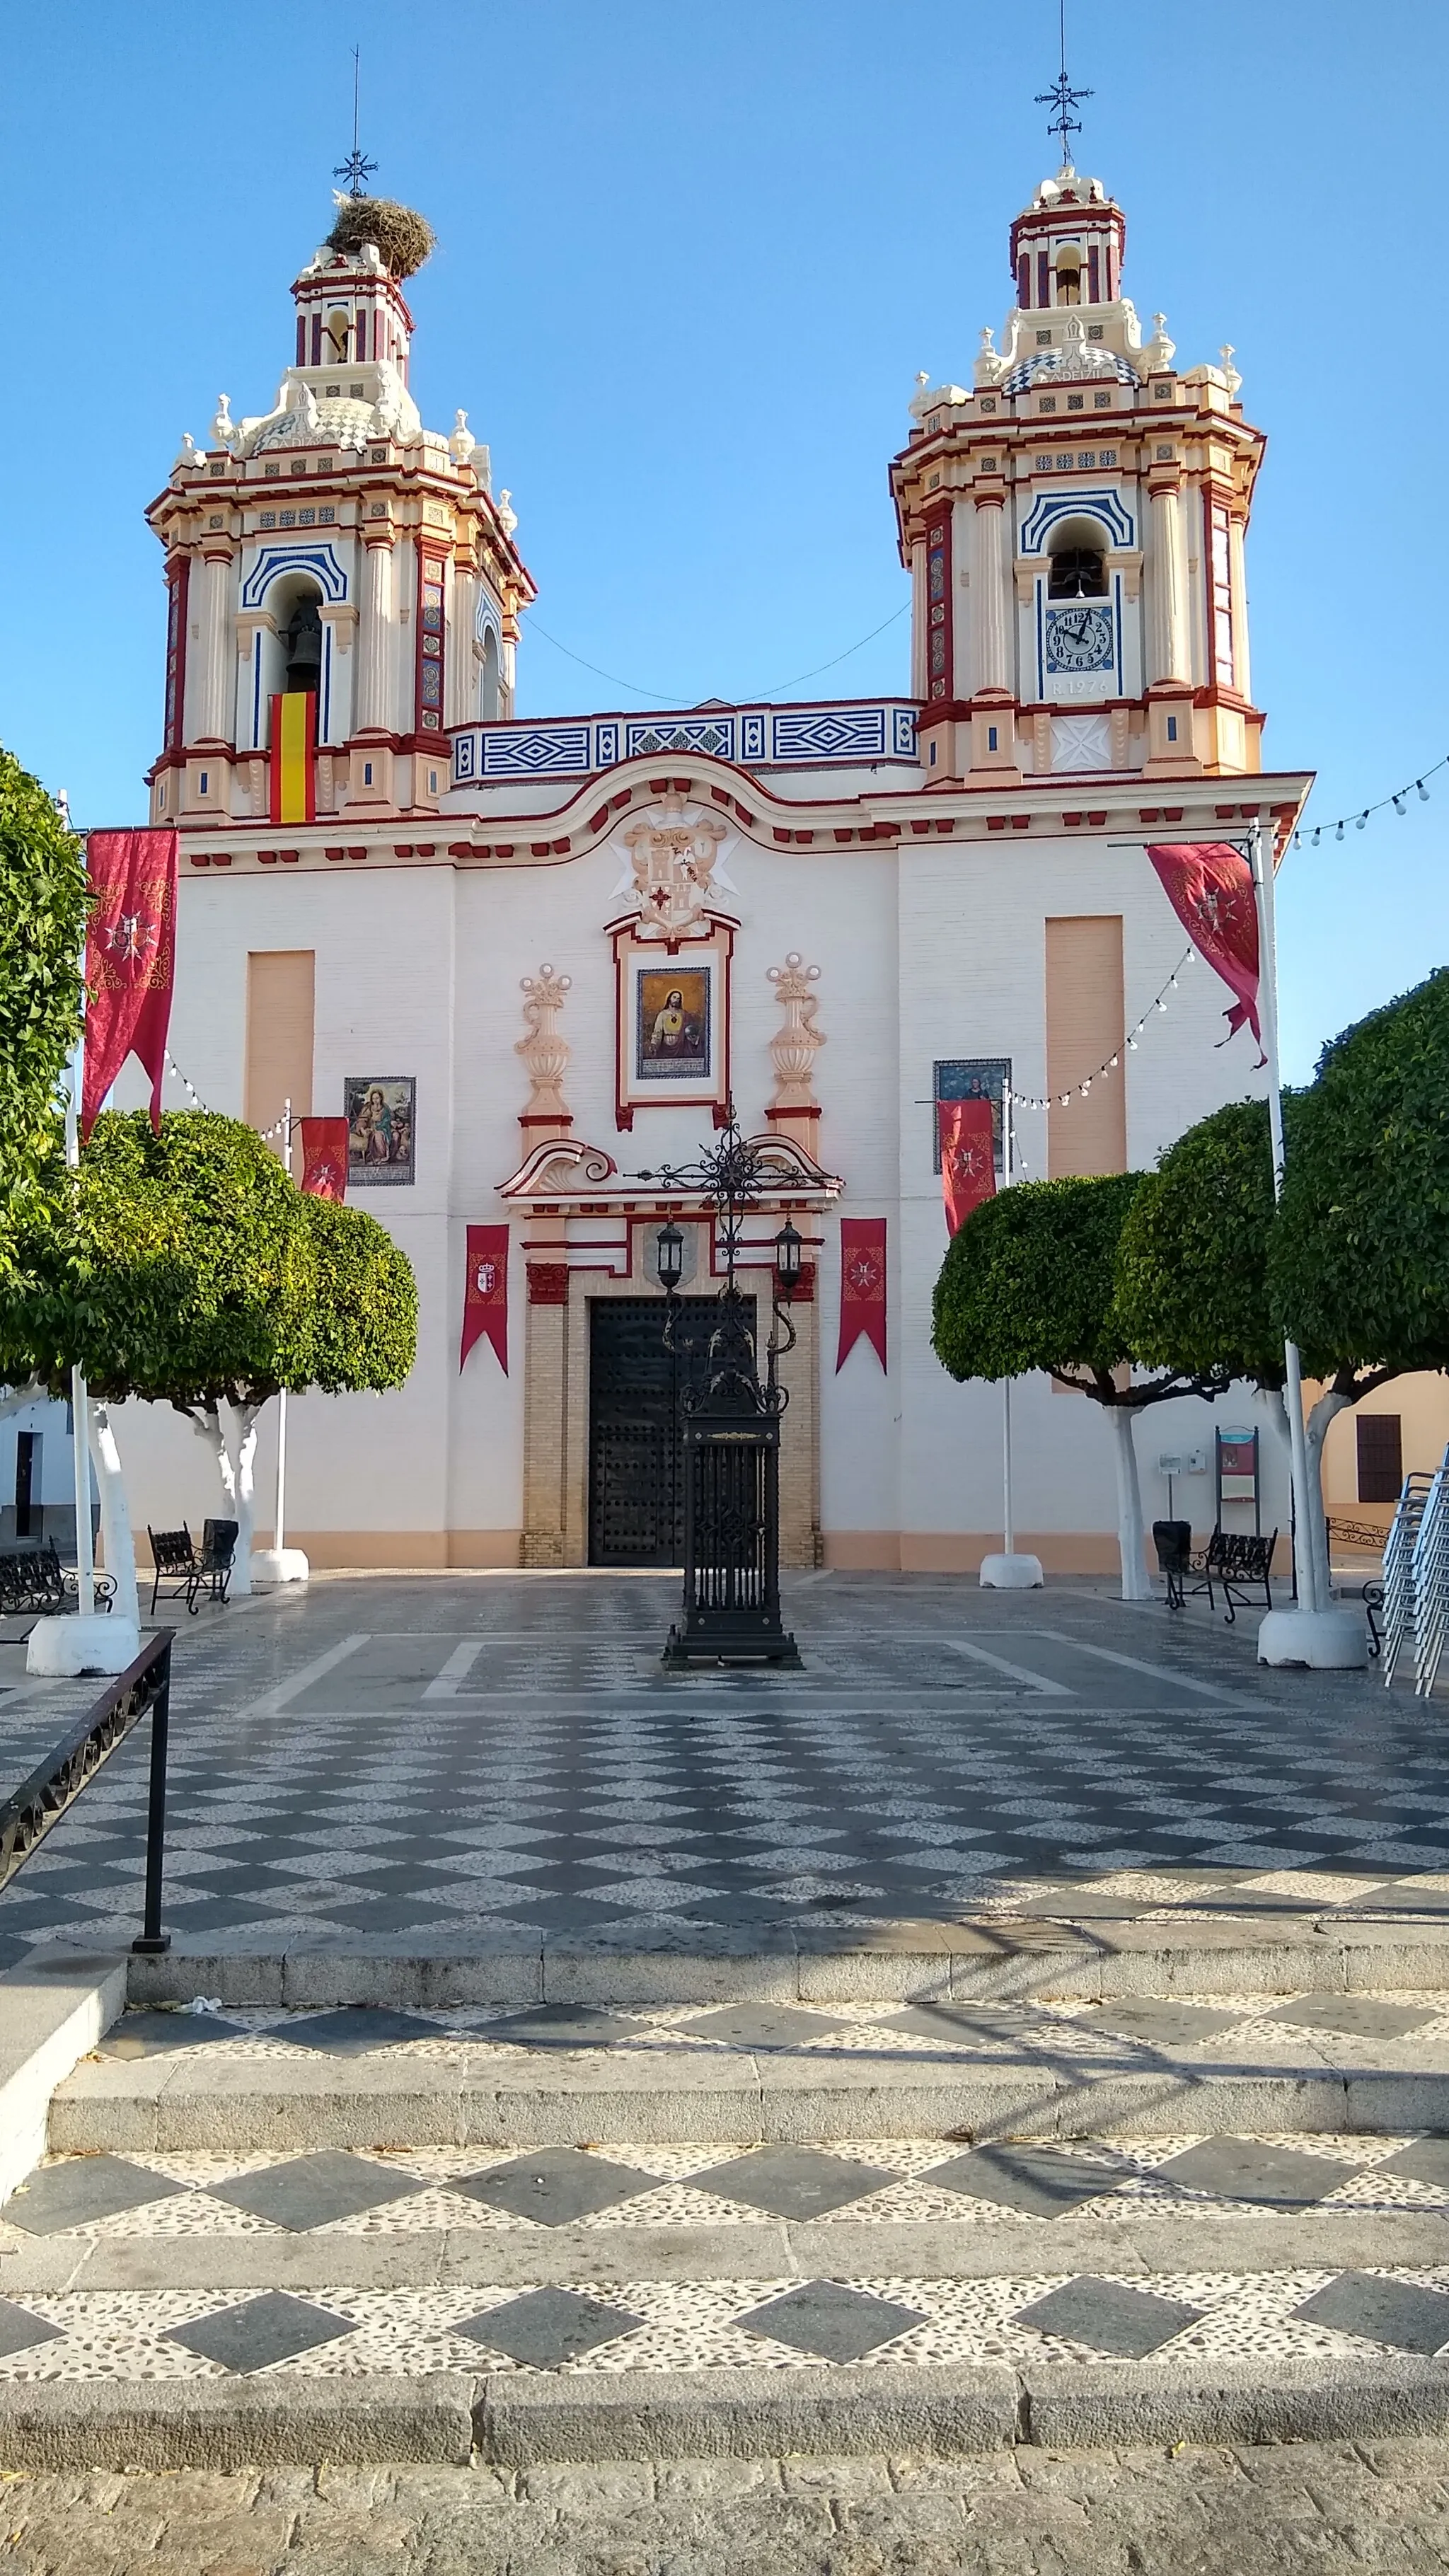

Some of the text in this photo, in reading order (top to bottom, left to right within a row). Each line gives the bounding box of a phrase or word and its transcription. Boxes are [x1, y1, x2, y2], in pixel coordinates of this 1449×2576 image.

[1064, 616, 1072, 626] 11
[1074, 613, 1084, 623] 12
[1055, 625, 1064, 635] 10
[1095, 622, 1102, 633] 2
[1053, 636, 1061, 646] 9
[1099, 633, 1106, 643] 3
[1056, 647, 1063, 658] 8
[1094, 645, 1102, 654] 4
[1066, 654, 1073, 665] 7
[1076, 657, 1083, 666] 6
[1087, 653, 1094, 664] 5
